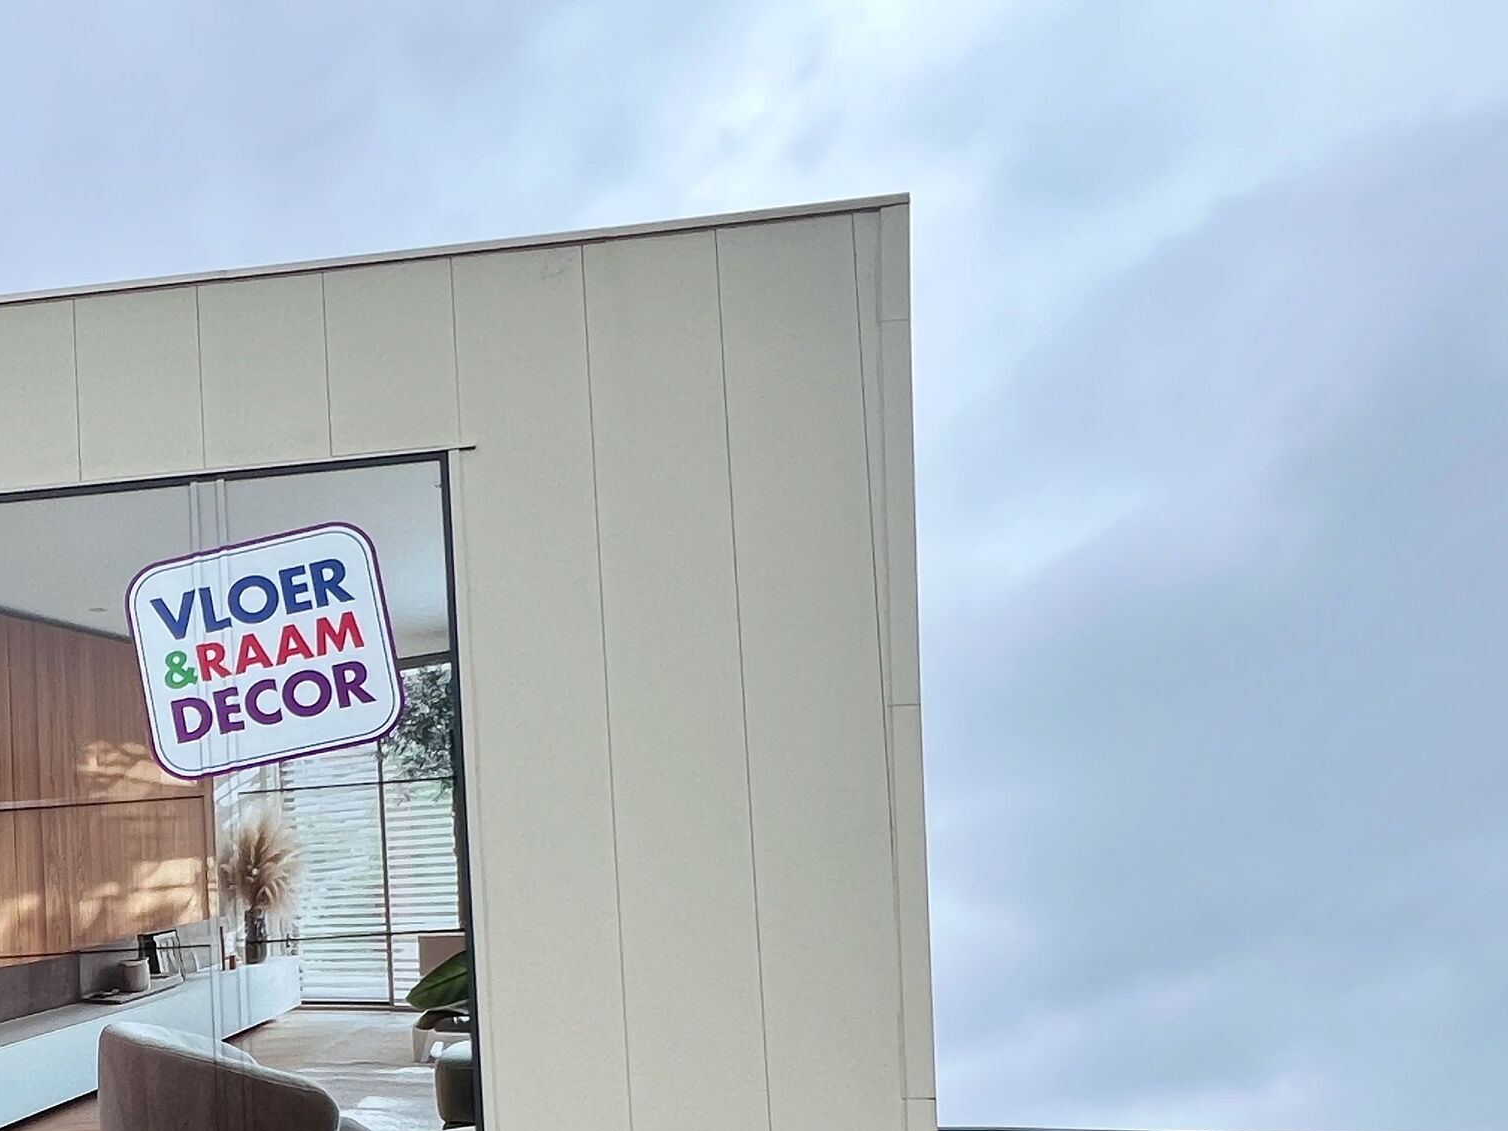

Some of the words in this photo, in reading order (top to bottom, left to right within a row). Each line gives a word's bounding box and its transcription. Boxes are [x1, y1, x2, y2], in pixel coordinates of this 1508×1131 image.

[149, 558, 356, 640] VLOER
[164, 611, 365, 690] &RAAM
[170, 661, 377, 744] DECOR
